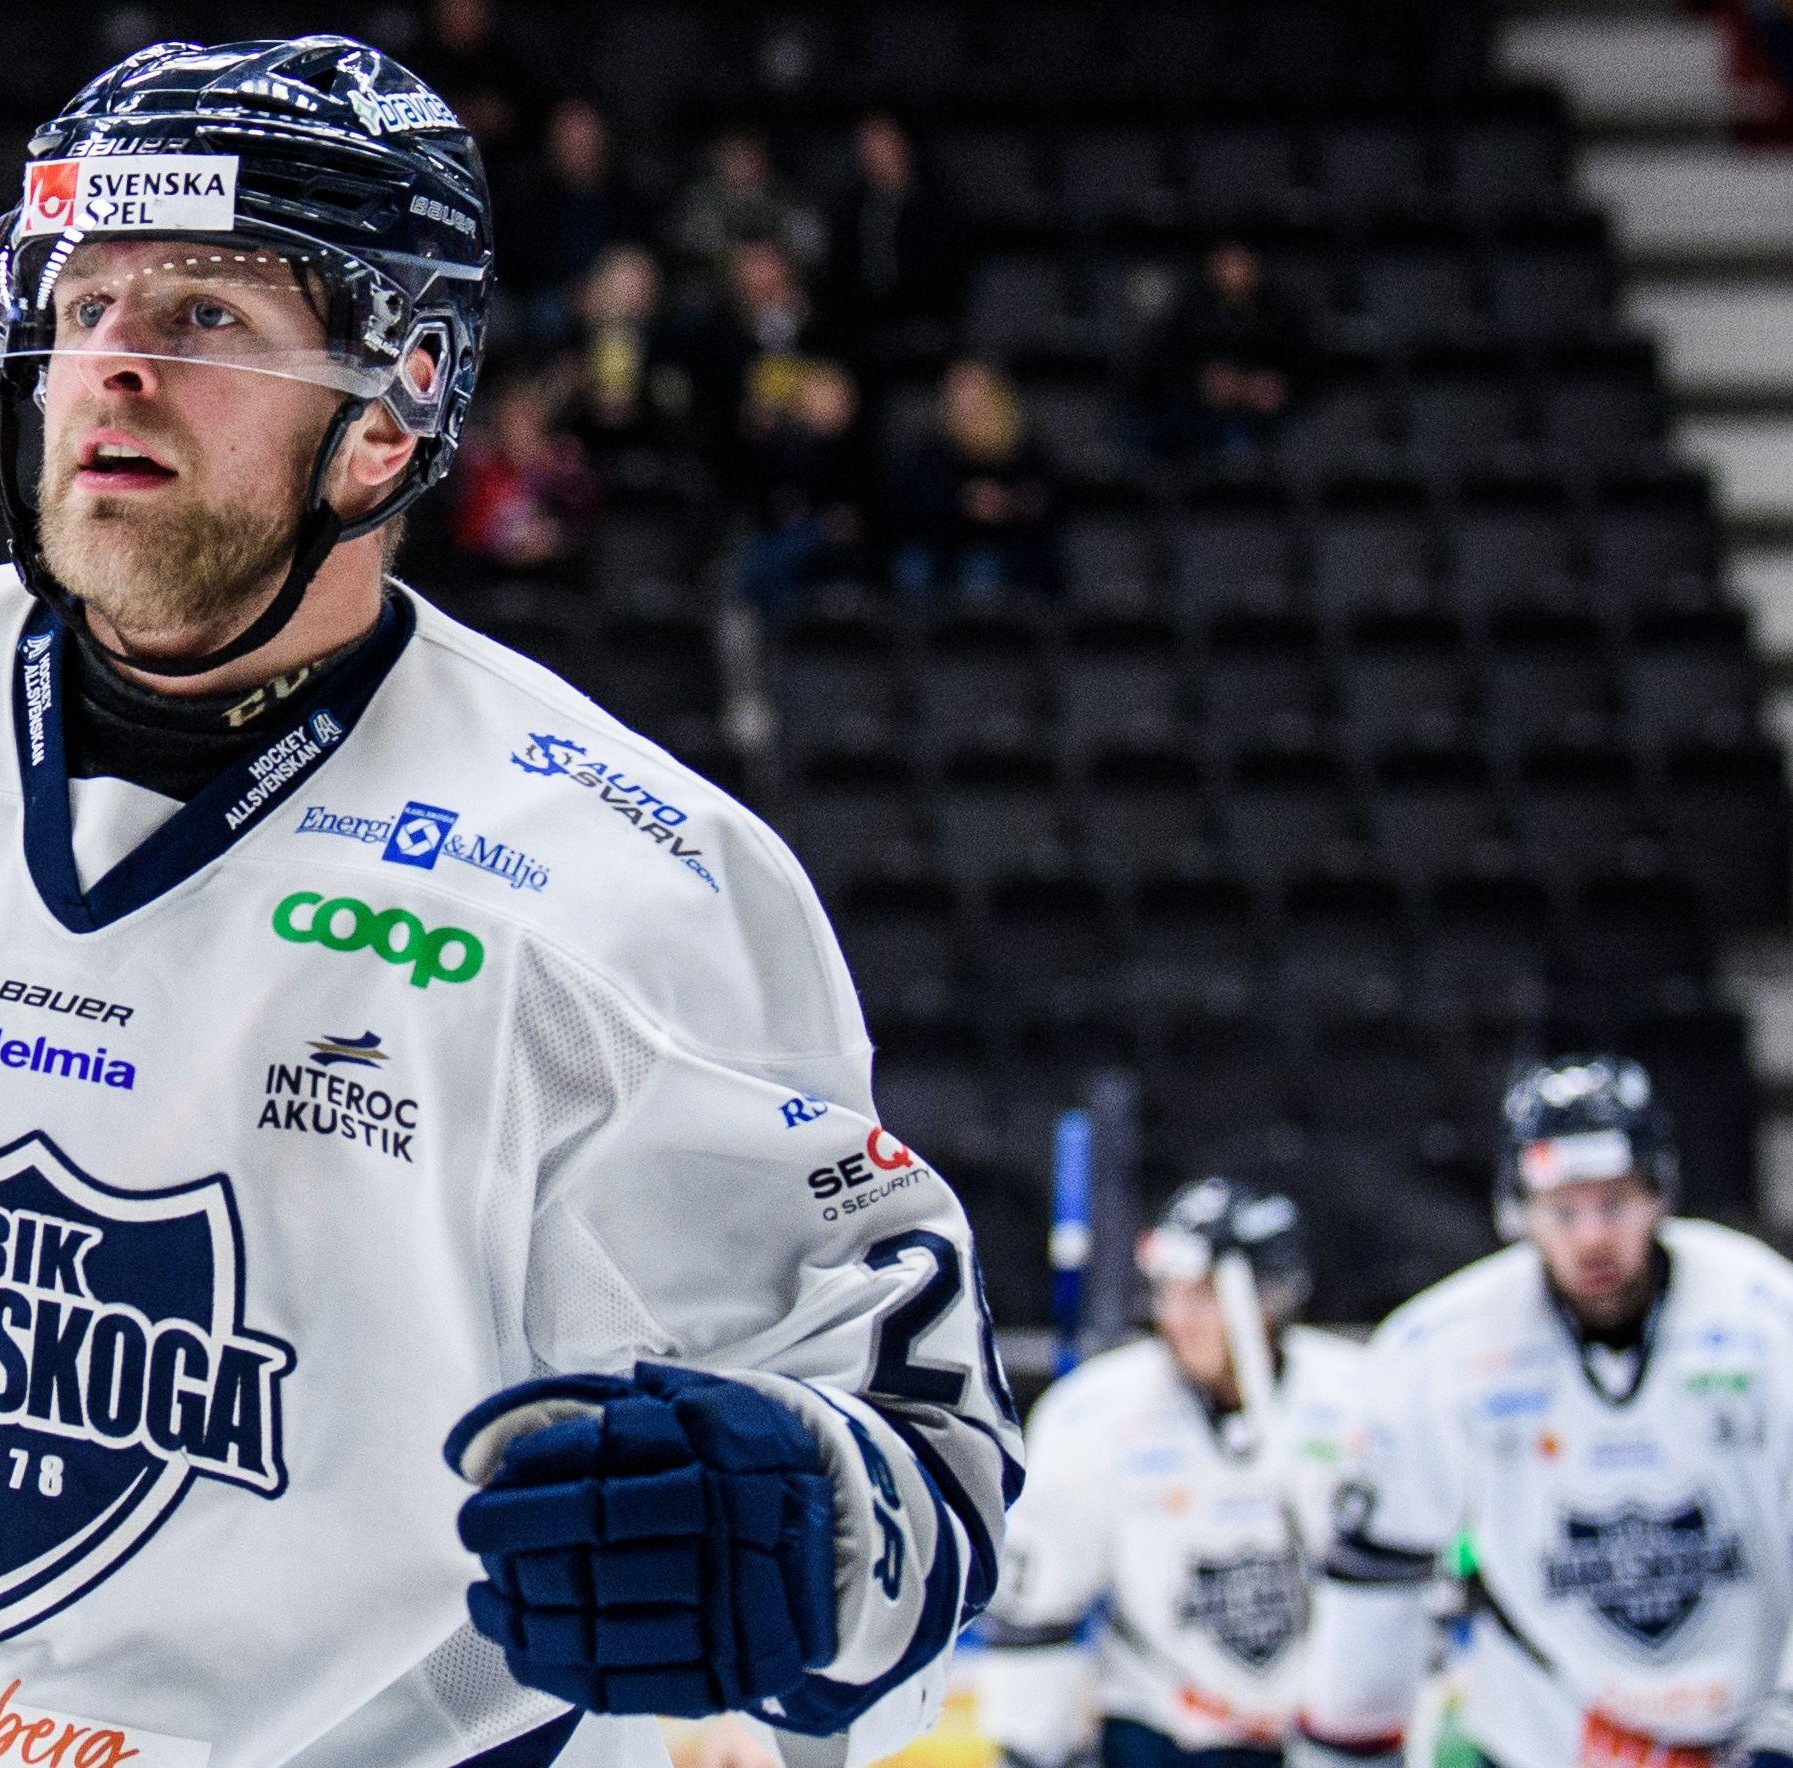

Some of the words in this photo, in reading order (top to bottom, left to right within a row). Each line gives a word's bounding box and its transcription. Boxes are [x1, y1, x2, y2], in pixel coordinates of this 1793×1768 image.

[87, 172, 226, 198] SVENSKA
[410, 194, 477, 240] BAUER
[23, 665, 45, 767] ALLSVENSKAN
[248, 725, 308, 780] HOCKEY
[224, 740, 322, 831] ALLSVENSKAN
[578, 761, 688, 827] AUTO
[296, 806, 396, 843] Energi
[272, 891, 485, 990] coop
[266, 1064, 419, 1130] INTEROC
[257, 1100, 415, 1164] AKUSTIK
